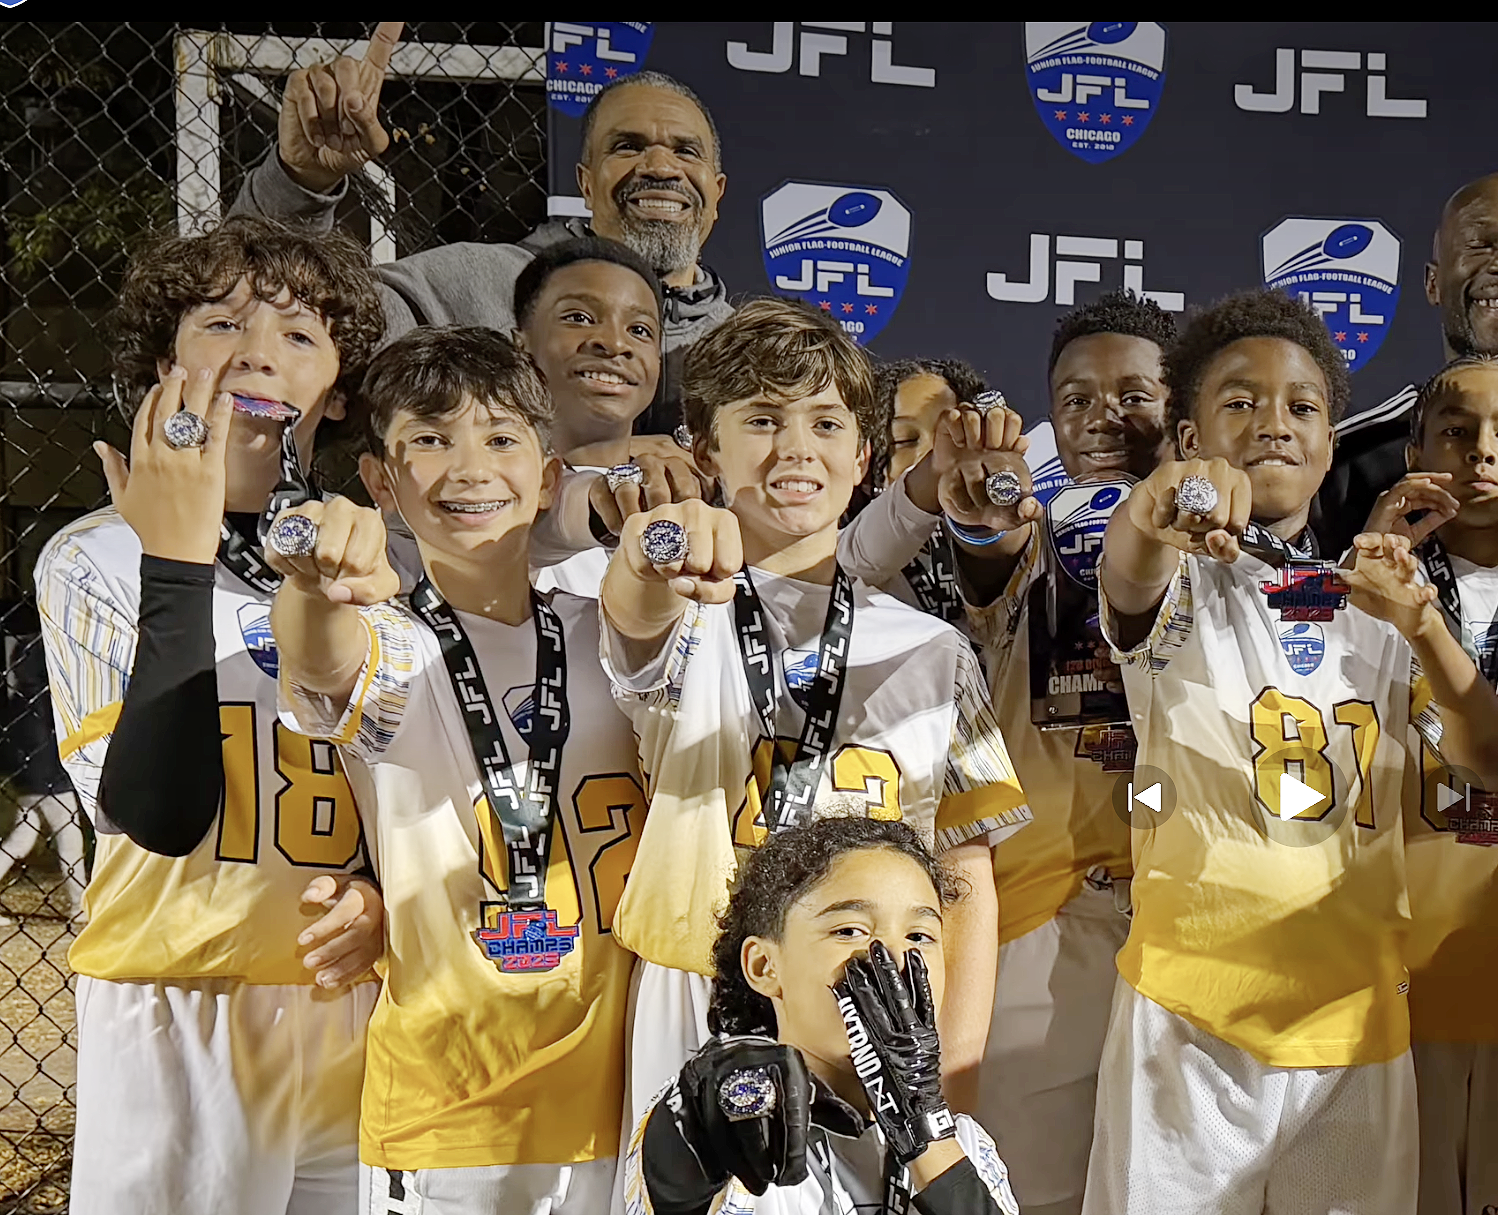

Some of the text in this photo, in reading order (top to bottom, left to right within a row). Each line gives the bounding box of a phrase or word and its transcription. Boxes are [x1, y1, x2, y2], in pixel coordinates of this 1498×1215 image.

[544, 21, 636, 63] FL
[727, 21, 935, 87] JFL
[1031, 57, 1061, 73] JUNIOR
[1128, 62, 1159, 80] LEAGUE
[1037, 73, 1149, 109] JFL
[1235, 48, 1427, 117] JFL
[1066, 128, 1121, 143] CHICAGO
[1072, 141, 1092, 149] EST.
[769, 240, 801, 259] JUNIOR
[871, 247, 904, 267] LEAGUE
[776, 259, 894, 298] JFL
[987, 233, 1185, 311] JFL
[1363, 277, 1393, 295] LEAGUE
[1060, 531, 1105, 555] JF
[420, 588, 462, 641] JFL
[833, 575, 851, 625] JFL
[742, 610, 769, 675] JFL
[820, 637, 846, 695] JFL
[455, 656, 492, 725] JFL
[540, 667, 562, 731] JFL
[802, 710, 832, 770] JFL
[1249, 686, 1376, 829] 81
[215, 702, 361, 870] 18
[483, 740, 520, 811] JFL
[529, 748, 557, 817] JFL
[776, 784, 812, 833] FL
[512, 826, 539, 898] JFL
[479, 912, 578, 939] JFL
[487, 938, 572, 957] CHAMPS
[503, 952, 560, 969] 2025
